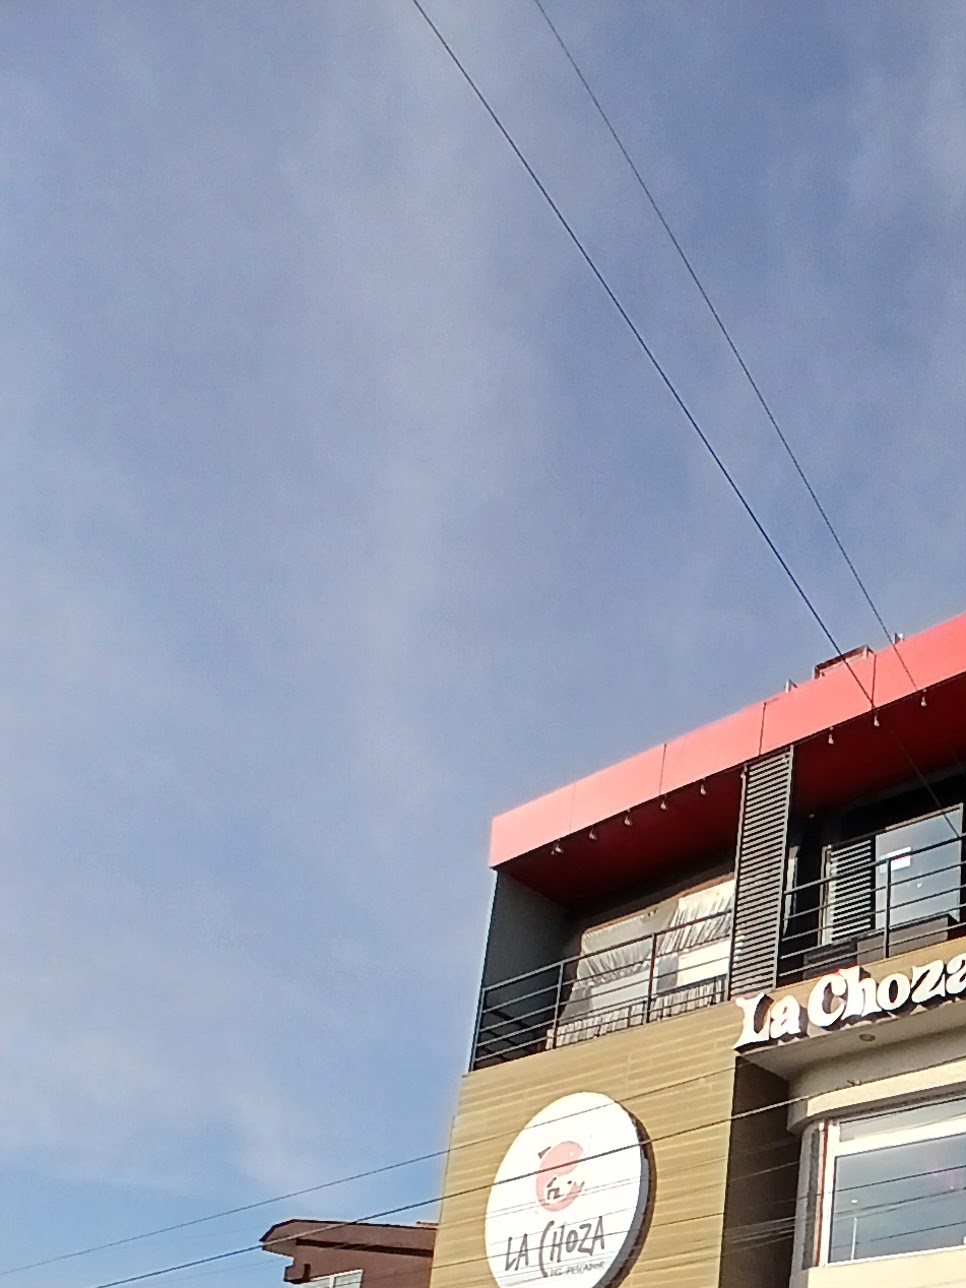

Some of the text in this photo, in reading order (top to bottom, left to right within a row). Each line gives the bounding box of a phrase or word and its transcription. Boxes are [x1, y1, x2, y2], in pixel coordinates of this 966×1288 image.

[734, 992, 801, 1049] La
[505, 1215, 605, 1278] LA CHOZA
